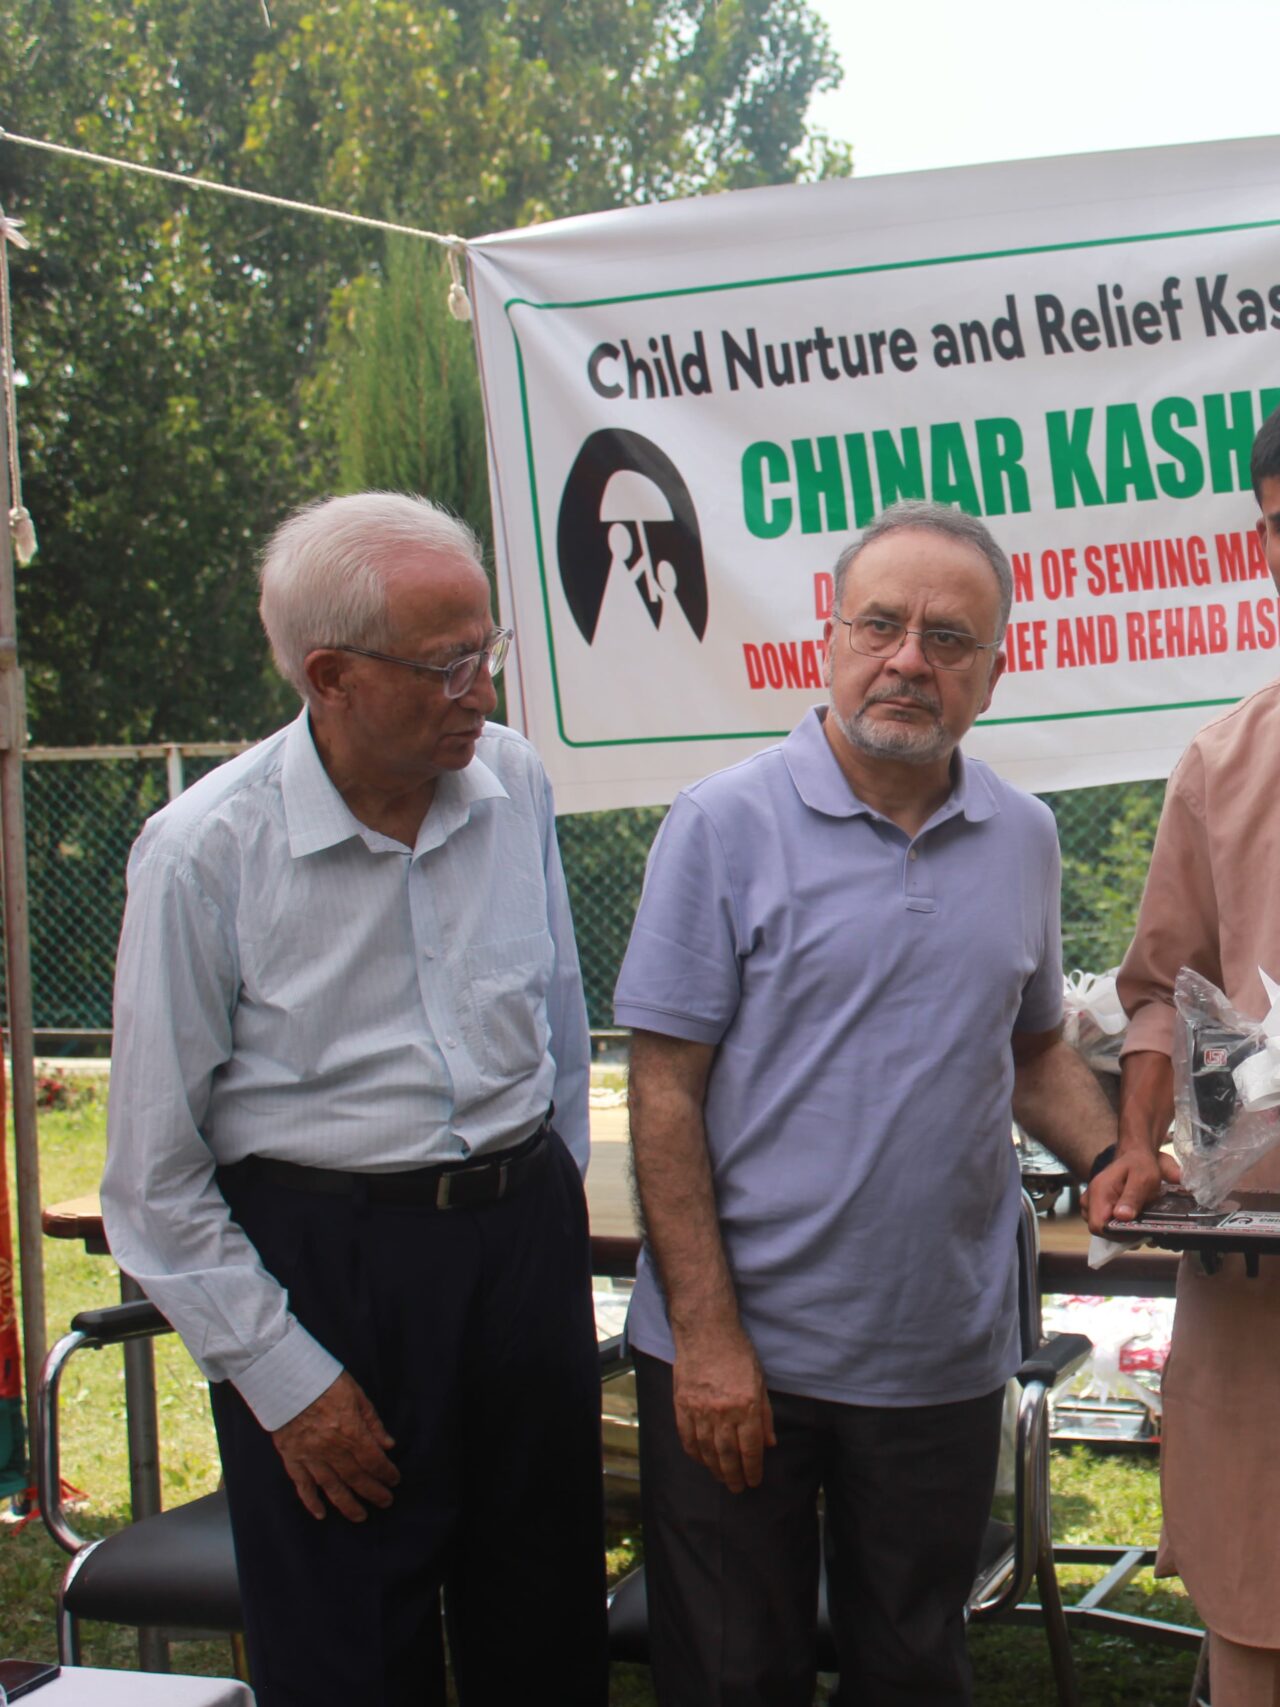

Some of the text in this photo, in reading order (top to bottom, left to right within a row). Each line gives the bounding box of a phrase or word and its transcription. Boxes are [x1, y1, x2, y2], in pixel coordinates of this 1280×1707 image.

[587, 330, 713, 399] Child
[721, 325, 918, 391] Nurture
[931, 294, 1026, 368] and
[1034, 276, 1183, 355] Relief
[740, 417, 1031, 539] CHINAR
[1040, 548, 1079, 601] OF
[1084, 534, 1212, 597] SEWING
[742, 639, 830, 690] DONA
[1056, 614, 1119, 669] AND
[1126, 603, 1229, 662] REHAB
